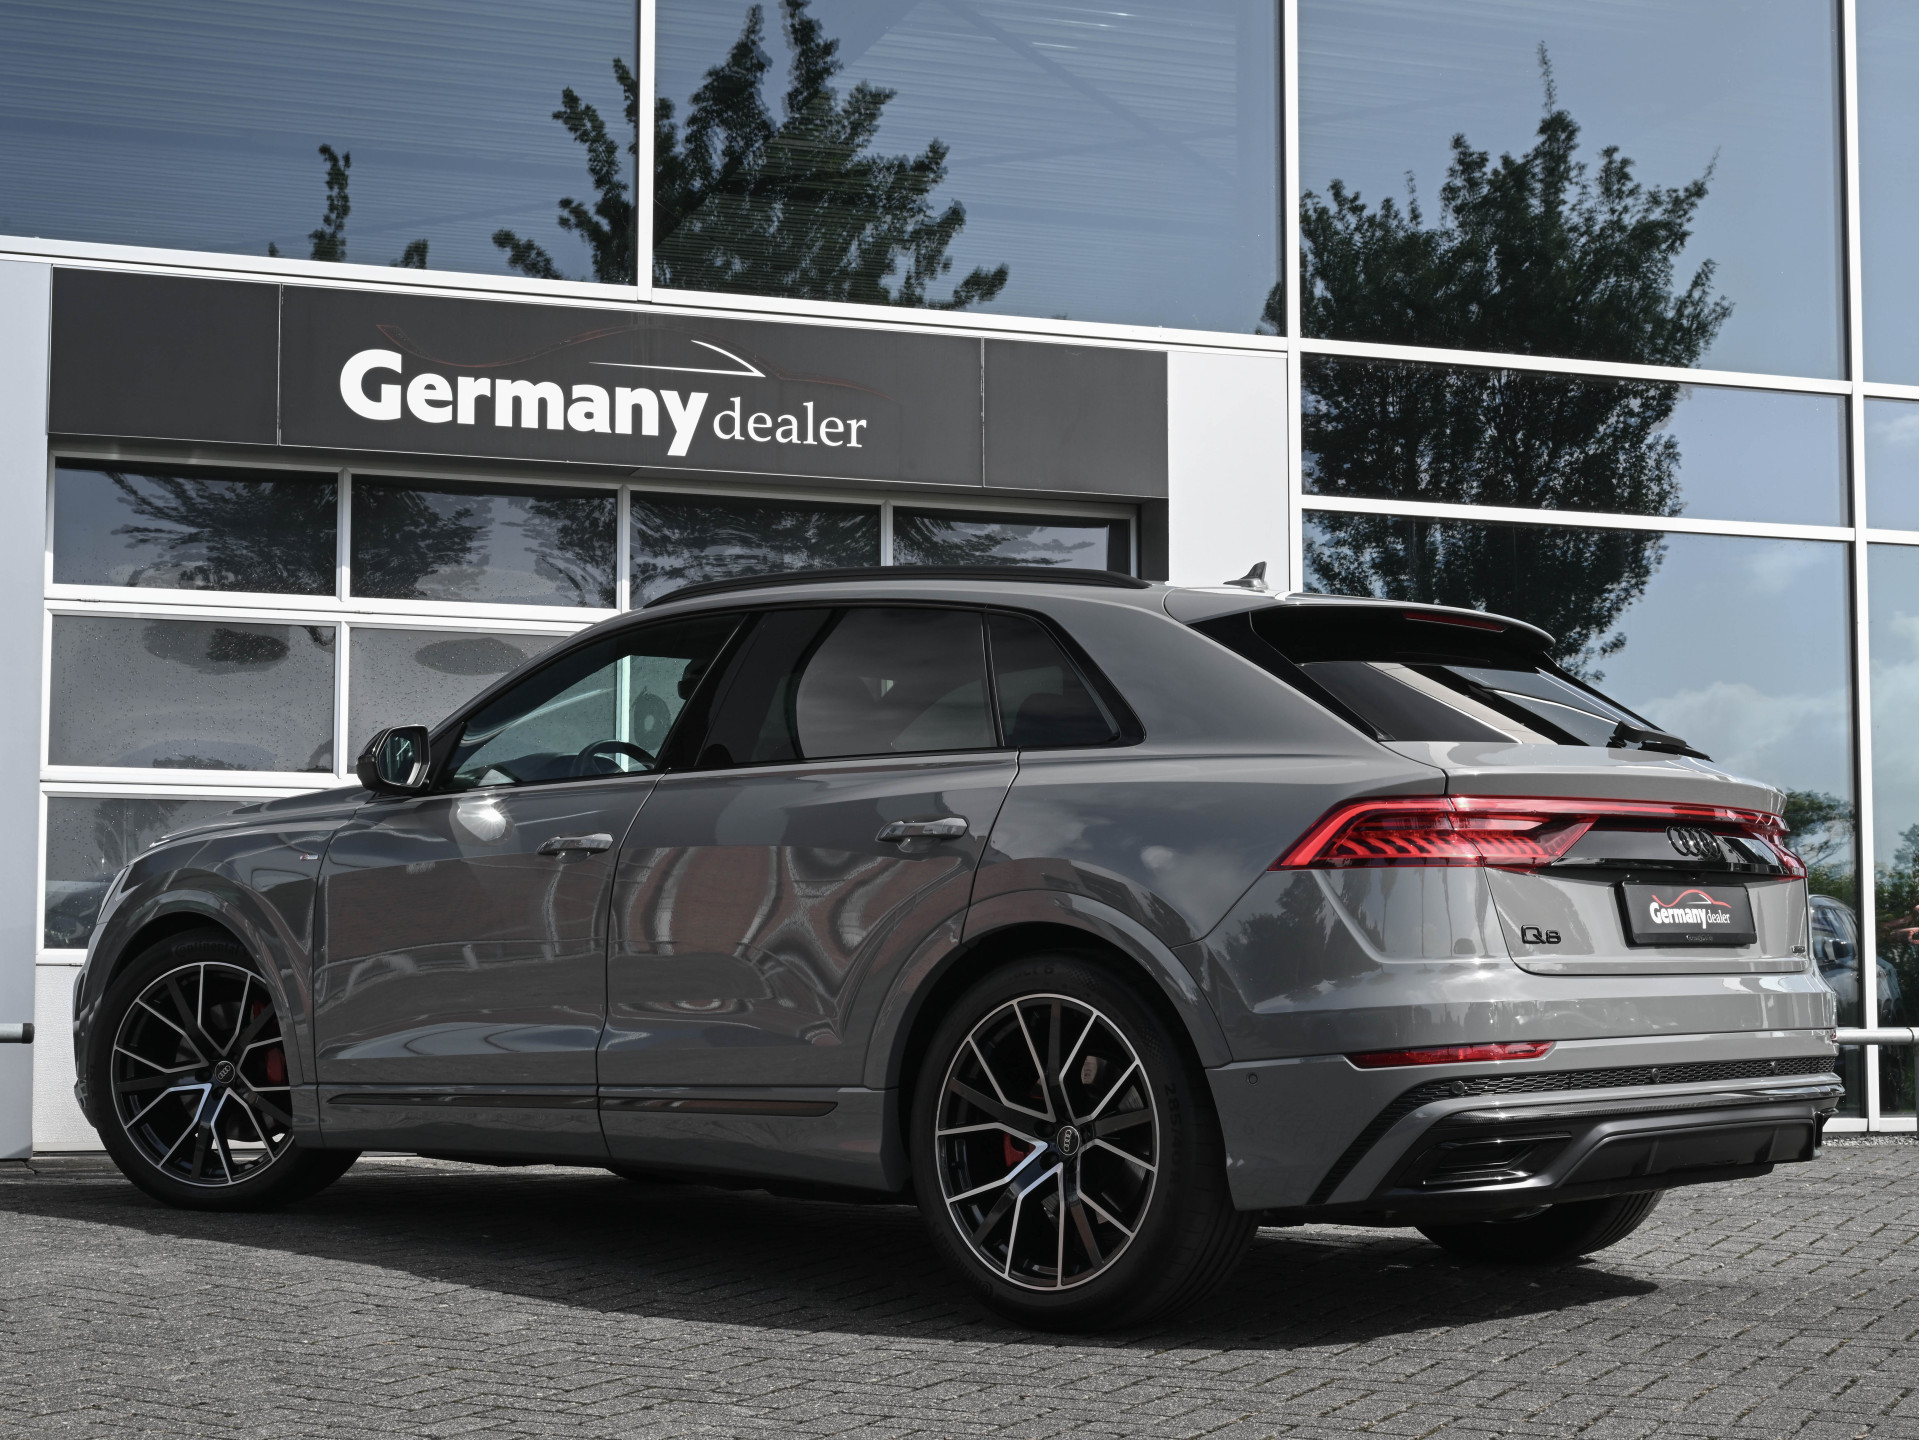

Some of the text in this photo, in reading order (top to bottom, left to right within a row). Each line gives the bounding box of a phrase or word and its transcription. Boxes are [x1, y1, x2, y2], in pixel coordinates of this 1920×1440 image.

[339, 348, 868, 457] Germany dealer
[1649, 901, 1731, 929] Germany dealer
[1520, 925, 1562, 945] Q8
